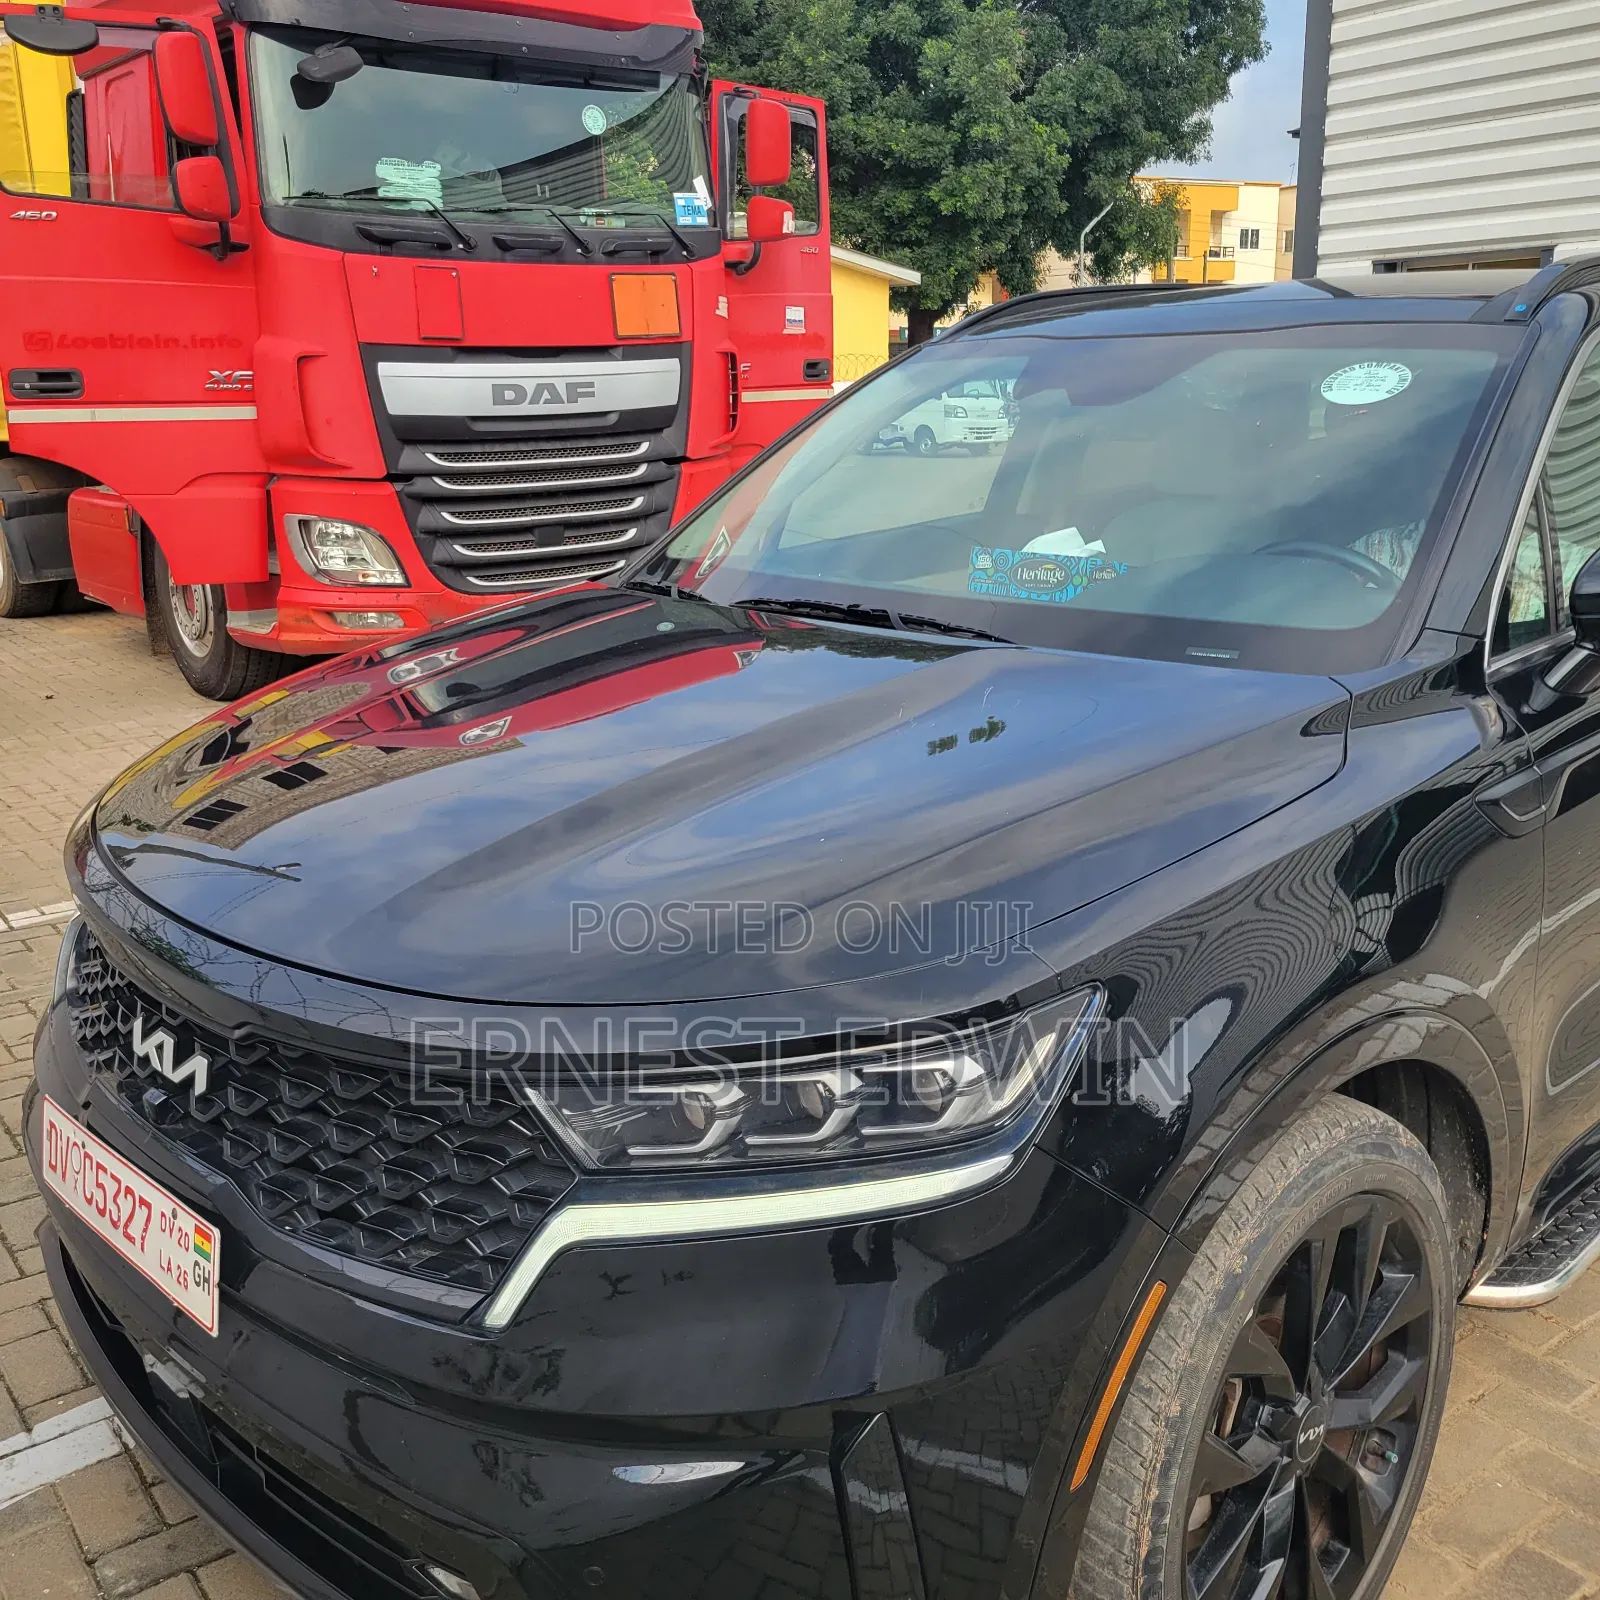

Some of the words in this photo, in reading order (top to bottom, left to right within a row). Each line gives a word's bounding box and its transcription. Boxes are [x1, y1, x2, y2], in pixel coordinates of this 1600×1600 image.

[9, 210, 58, 222] 460
[682, 205, 703, 216] TEMA
[800, 246, 819, 254] 460
[206, 370, 254, 384] XF
[491, 381, 596, 406] DAF
[1017, 566, 1065, 584] Heritage
[48, 1118, 71, 1182] DV
[82, 1150, 153, 1254] C5327
[160, 1210, 175, 1239] DV
[177, 1225, 190, 1253] 20
[159, 1248, 174, 1279] LA
[176, 1263, 189, 1291] 26
[193, 1259, 211, 1297] GH
